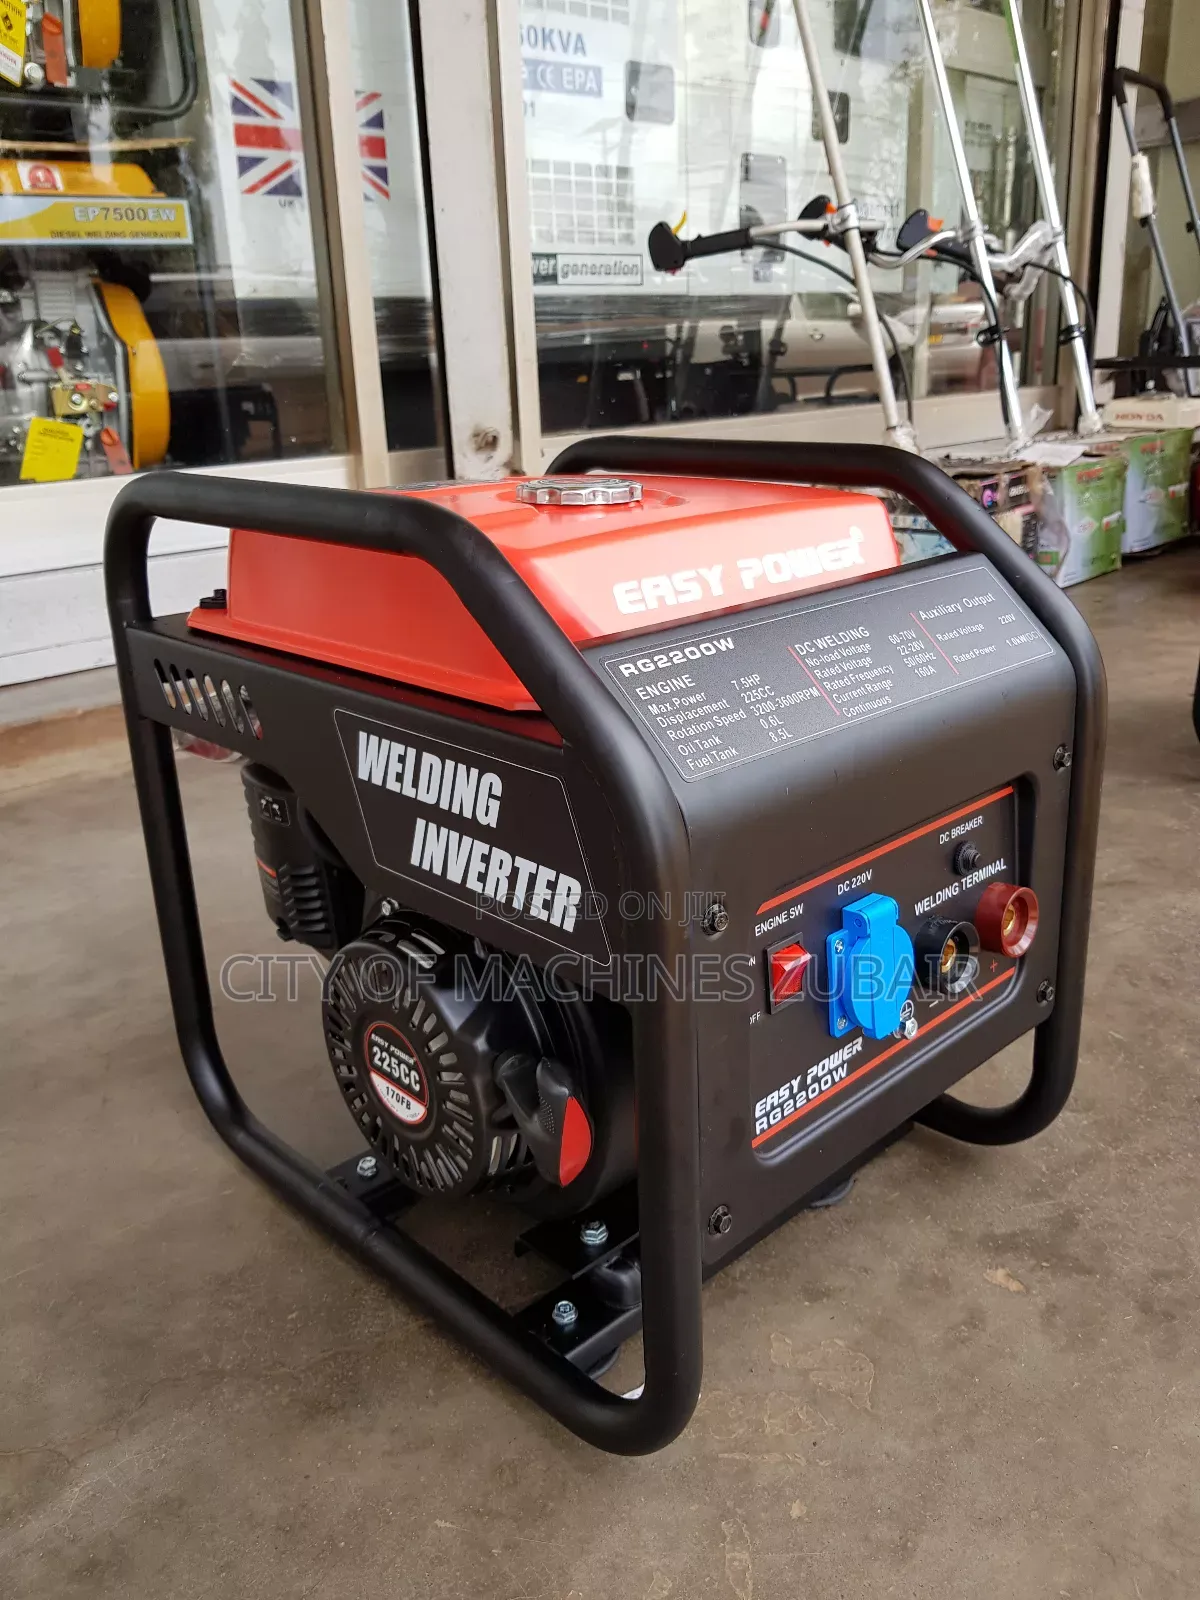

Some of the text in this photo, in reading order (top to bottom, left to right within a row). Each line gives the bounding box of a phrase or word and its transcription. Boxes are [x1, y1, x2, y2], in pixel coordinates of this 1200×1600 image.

[561, 67, 599, 92] EPA
[73, 206, 176, 222] EP7500EW
[50, 230, 181, 239] DIESEL WELDING GENERATOR
[560, 259, 640, 280] generation
[612, 535, 865, 615] EASY POWER
[918, 592, 996, 621] Auxiliary Output
[795, 626, 870, 656] DC WELDING
[935, 613, 1016, 642] Rated Voltage 220V
[618, 637, 735, 678] RG2200W
[805, 628, 916, 668] No-load Voltage 60-70V
[814, 639, 925, 680] Rated Voltage 22-28V
[952, 650, 976, 664] Rated
[973, 645, 997, 657] Power
[635, 674, 696, 700] ENGINE
[823, 651, 936, 692] Rated Frequency 50/60Hz
[832, 664, 937, 704] Current Range 160A
[648, 673, 761, 716] Max.Power 7.5HP
[656, 685, 775, 728] Displacement 225CC
[666, 686, 821, 741] Rotation Speed 3200-3600RPM
[842, 695, 892, 718] Continuous
[678, 714, 784, 756] Oil Tank 0.6L
[686, 727, 794, 770] Fuel Tank 8.5L
[357, 730, 503, 829] WELDING
[939, 815, 983, 845] DC BREAKER
[410, 816, 583, 933] INVERTER
[837, 868, 873, 896] DC 220V
[914, 858, 1007, 916] WELDING TERMINAL
[371, 1033, 415, 1066] EASY POWER
[372, 1045, 420, 1092] 225CC
[755, 1036, 863, 1119] EASY POWER
[385, 1086, 412, 1111] 170FB
[755, 1062, 848, 1136] RG2200W
